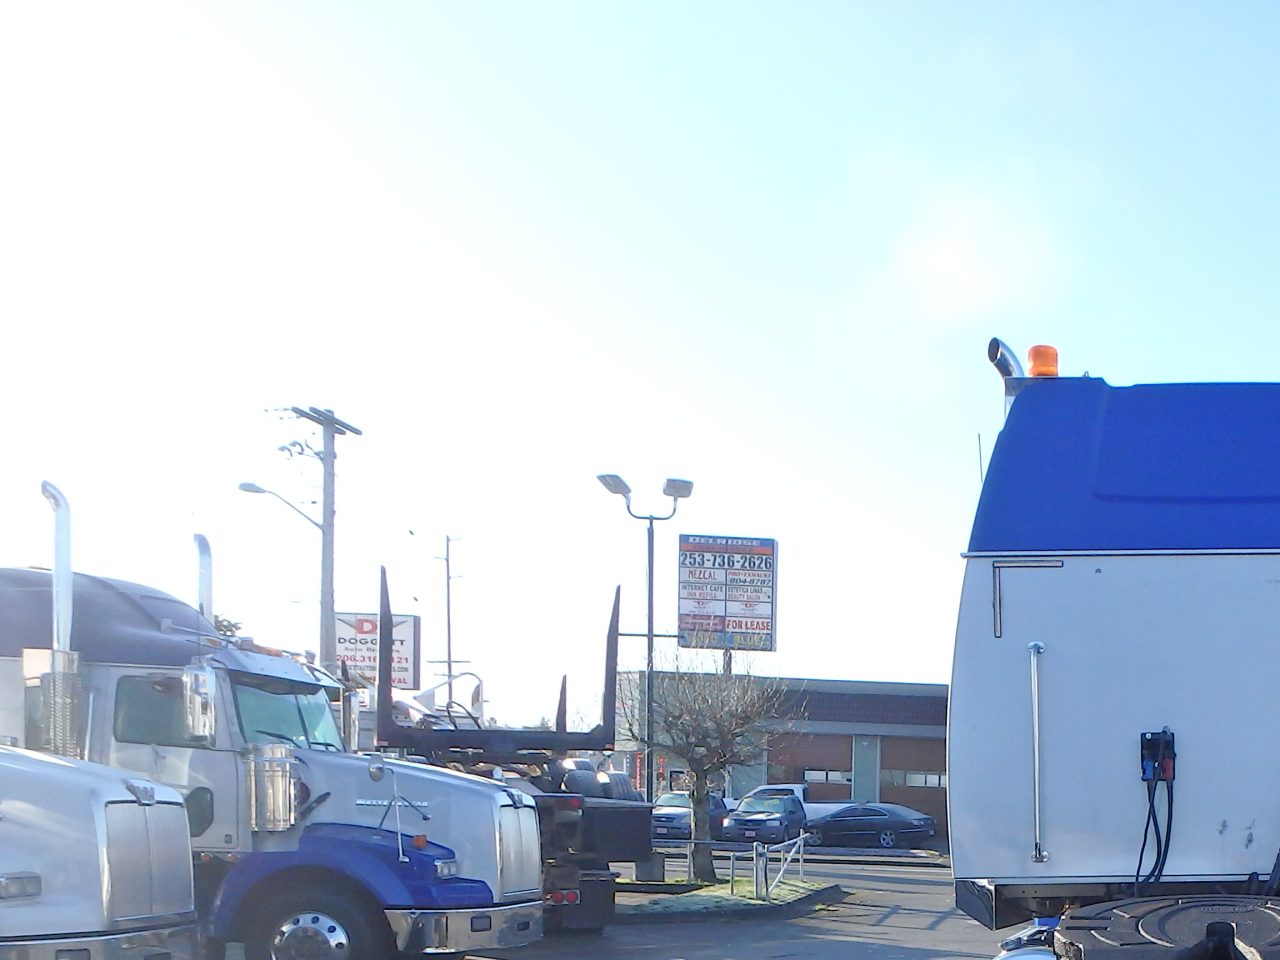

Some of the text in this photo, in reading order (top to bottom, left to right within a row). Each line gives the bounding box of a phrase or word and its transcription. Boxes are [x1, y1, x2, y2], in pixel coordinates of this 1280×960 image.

[681, 553, 772, 570] 253-736-2626
[688, 569, 717, 580] MEZCAL
[726, 619, 743, 629] FOR
[745, 620, 771, 631] LEASE
